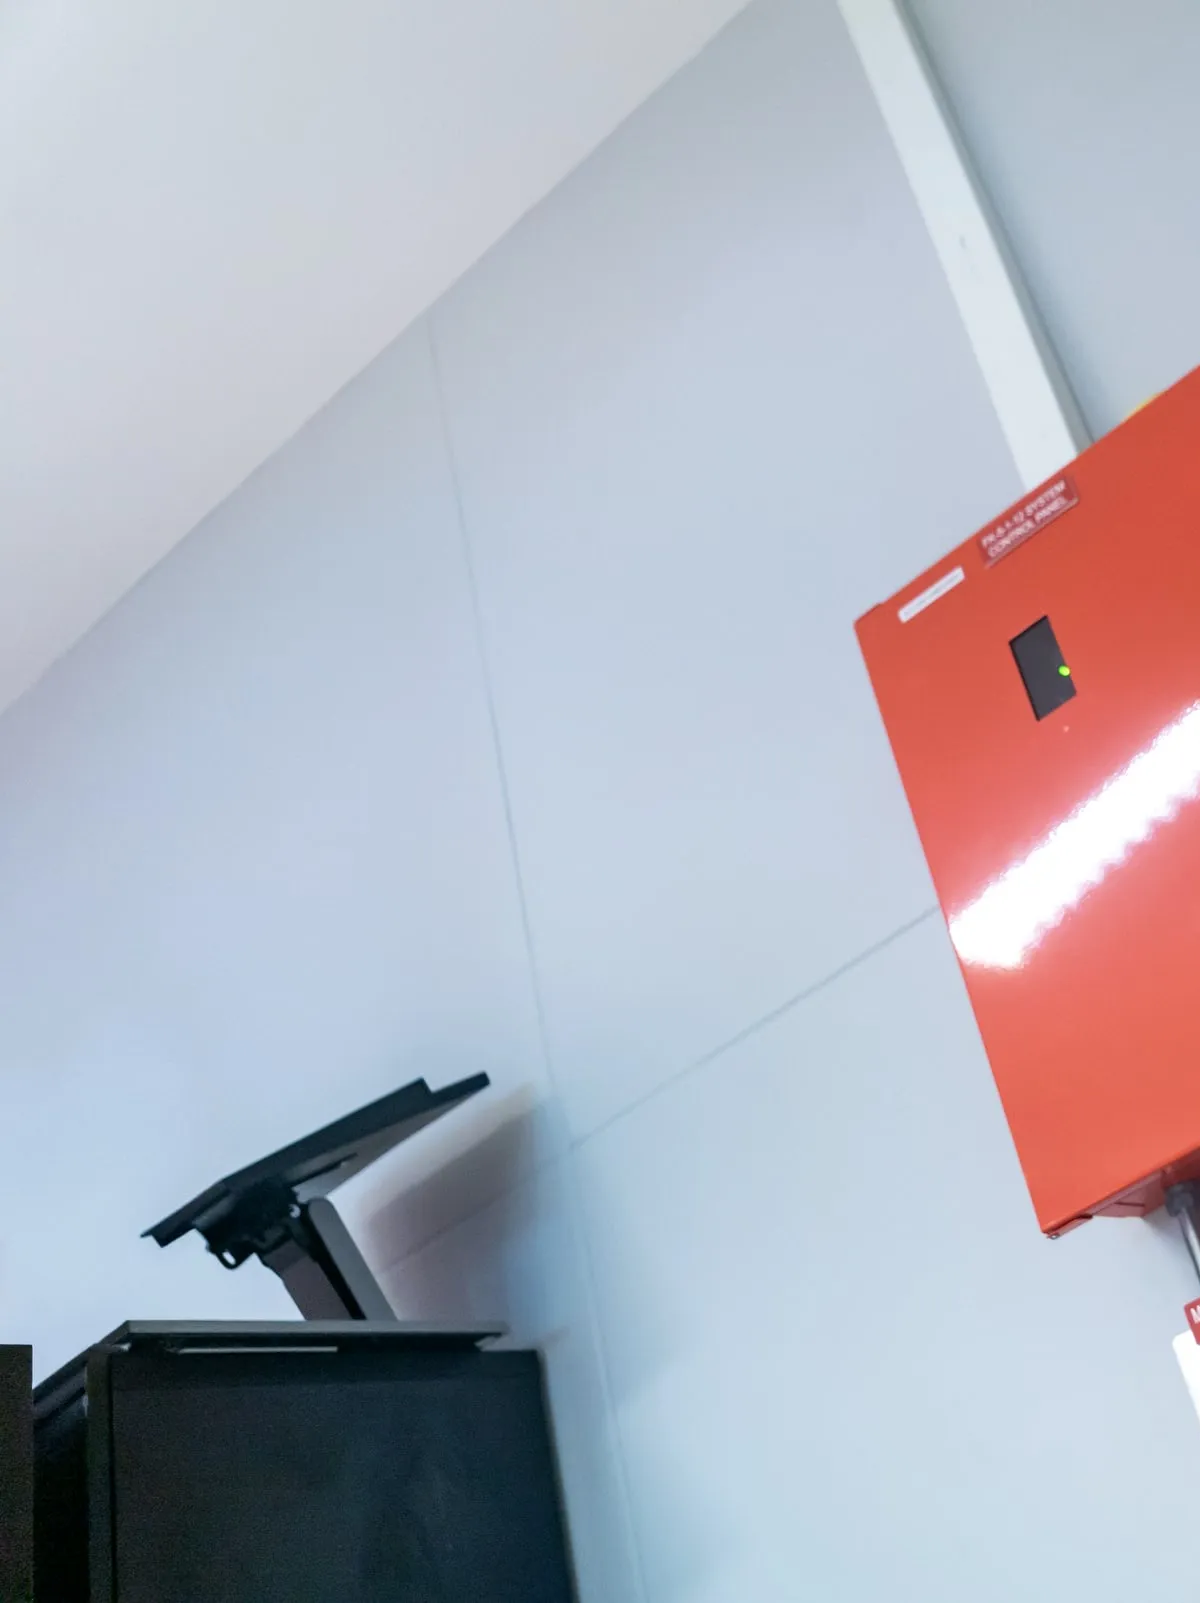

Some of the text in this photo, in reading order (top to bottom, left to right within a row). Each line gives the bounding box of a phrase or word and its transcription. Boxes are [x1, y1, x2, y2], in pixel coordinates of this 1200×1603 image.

[1024, 479, 1067, 517] SYSTEM
[987, 495, 1070, 558] CONTROL PANEL
